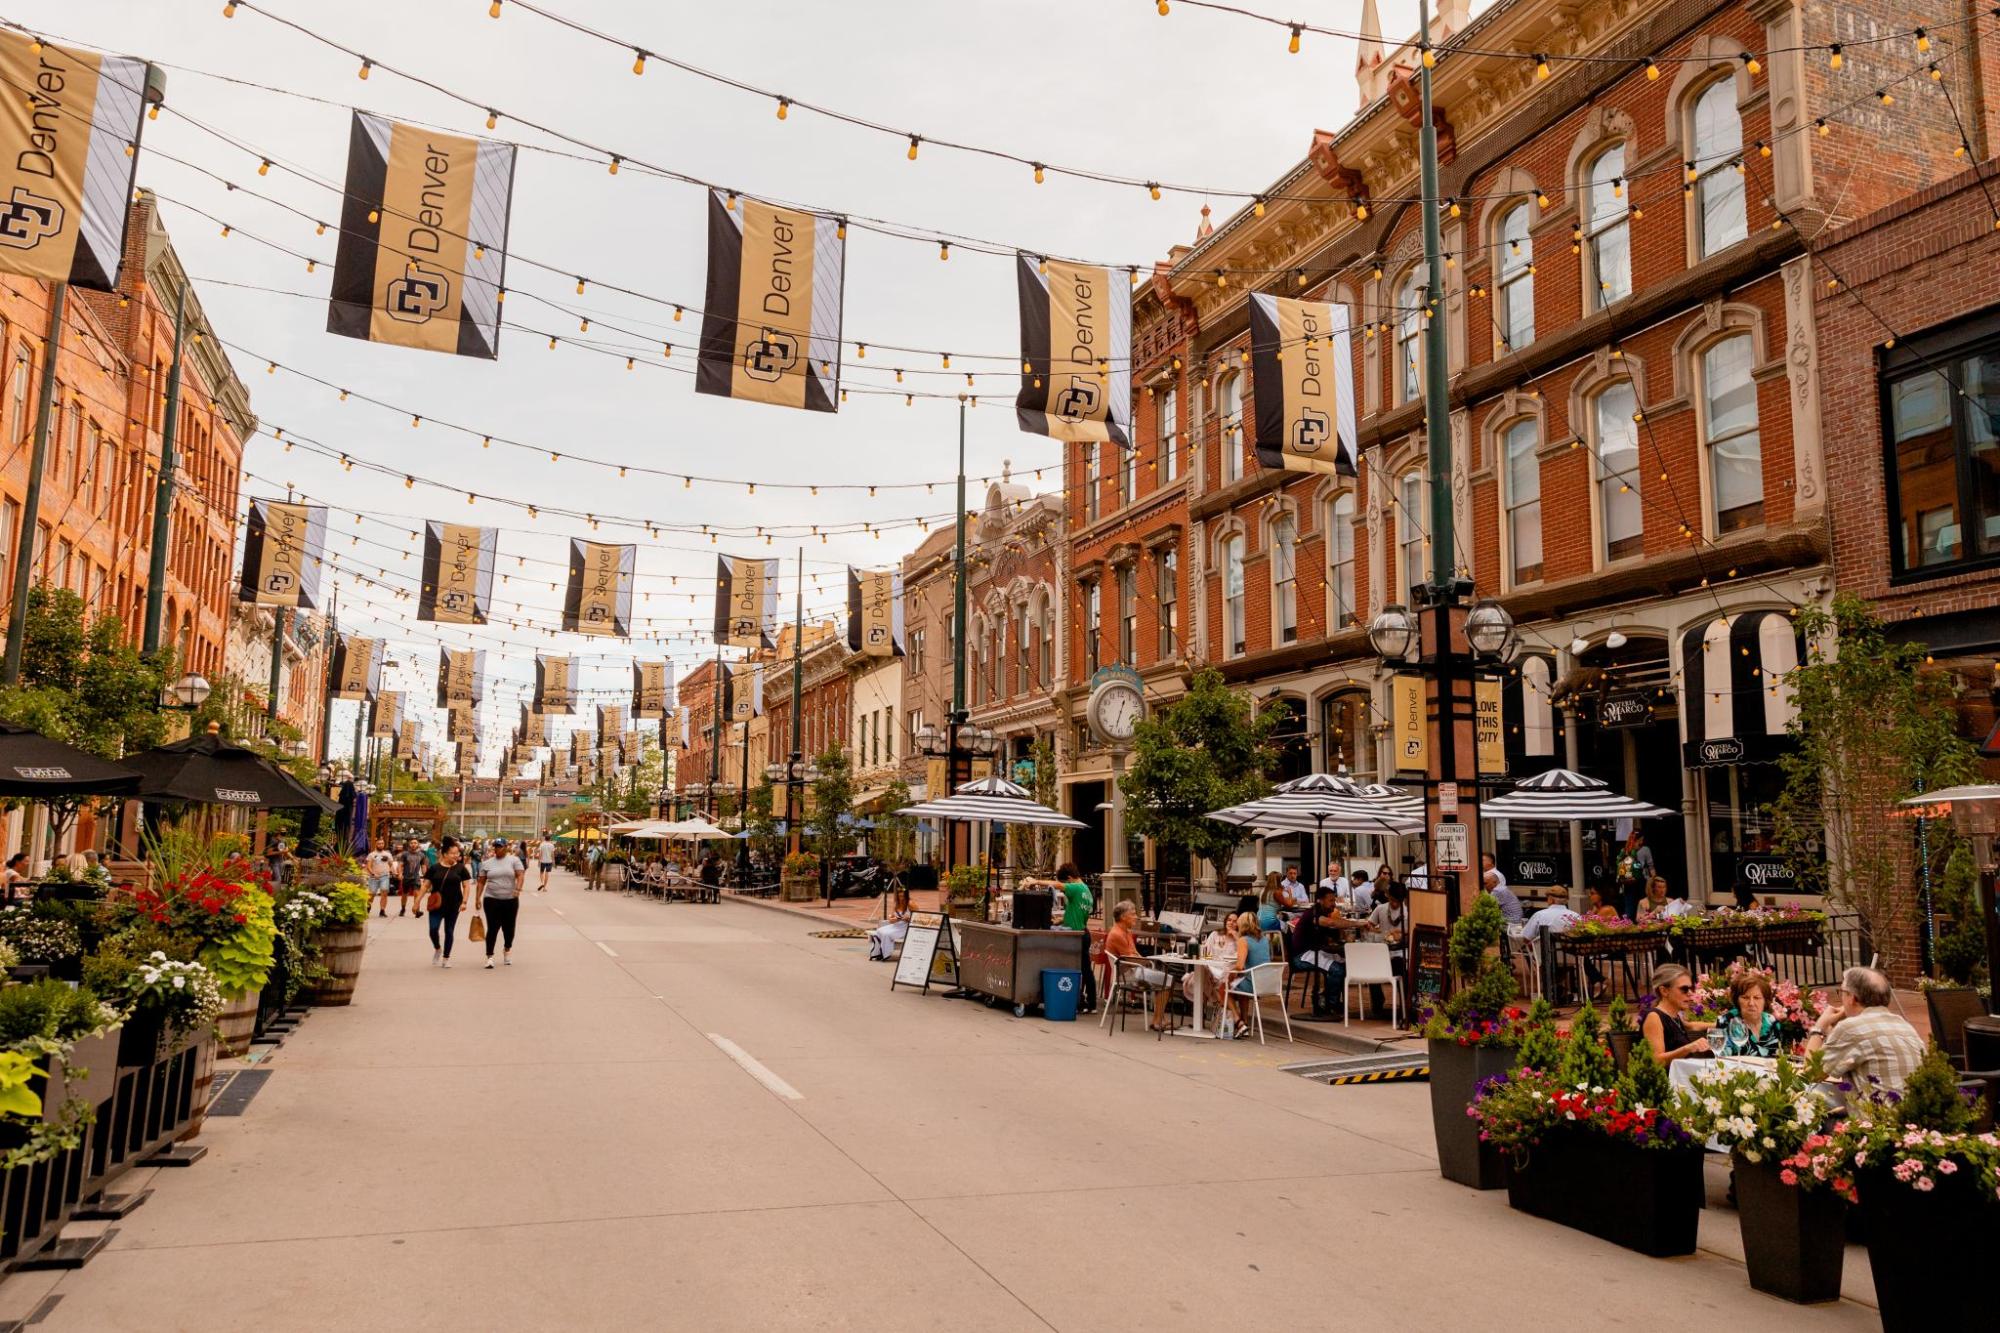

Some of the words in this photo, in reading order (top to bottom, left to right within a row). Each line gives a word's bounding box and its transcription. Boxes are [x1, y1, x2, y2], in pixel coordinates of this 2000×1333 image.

[17, 57, 66, 179] Denver
[408, 143, 450, 254] Denver
[763, 214, 794, 316] Denver
[1071, 273, 1093, 366] Denver
[1301, 308, 1319, 397] Denver
[275, 511, 295, 564] Denver
[451, 532, 469, 582] Denver
[594, 549, 611, 596] Denver
[741, 564, 755, 611] Denver
[872, 573, 885, 618] Denver
[1408, 688, 1418, 731] Denver
[1476, 717, 1498, 728] THIS
[1608, 704, 1644, 722] MARCO
[1478, 732, 1499, 743] CITY
[1708, 747, 1738, 759] MARCO
[1523, 866, 1553, 880] MARCO
[1745, 863, 1785, 880] OSTERIA
[1751, 868, 1795, 885] MARCO
